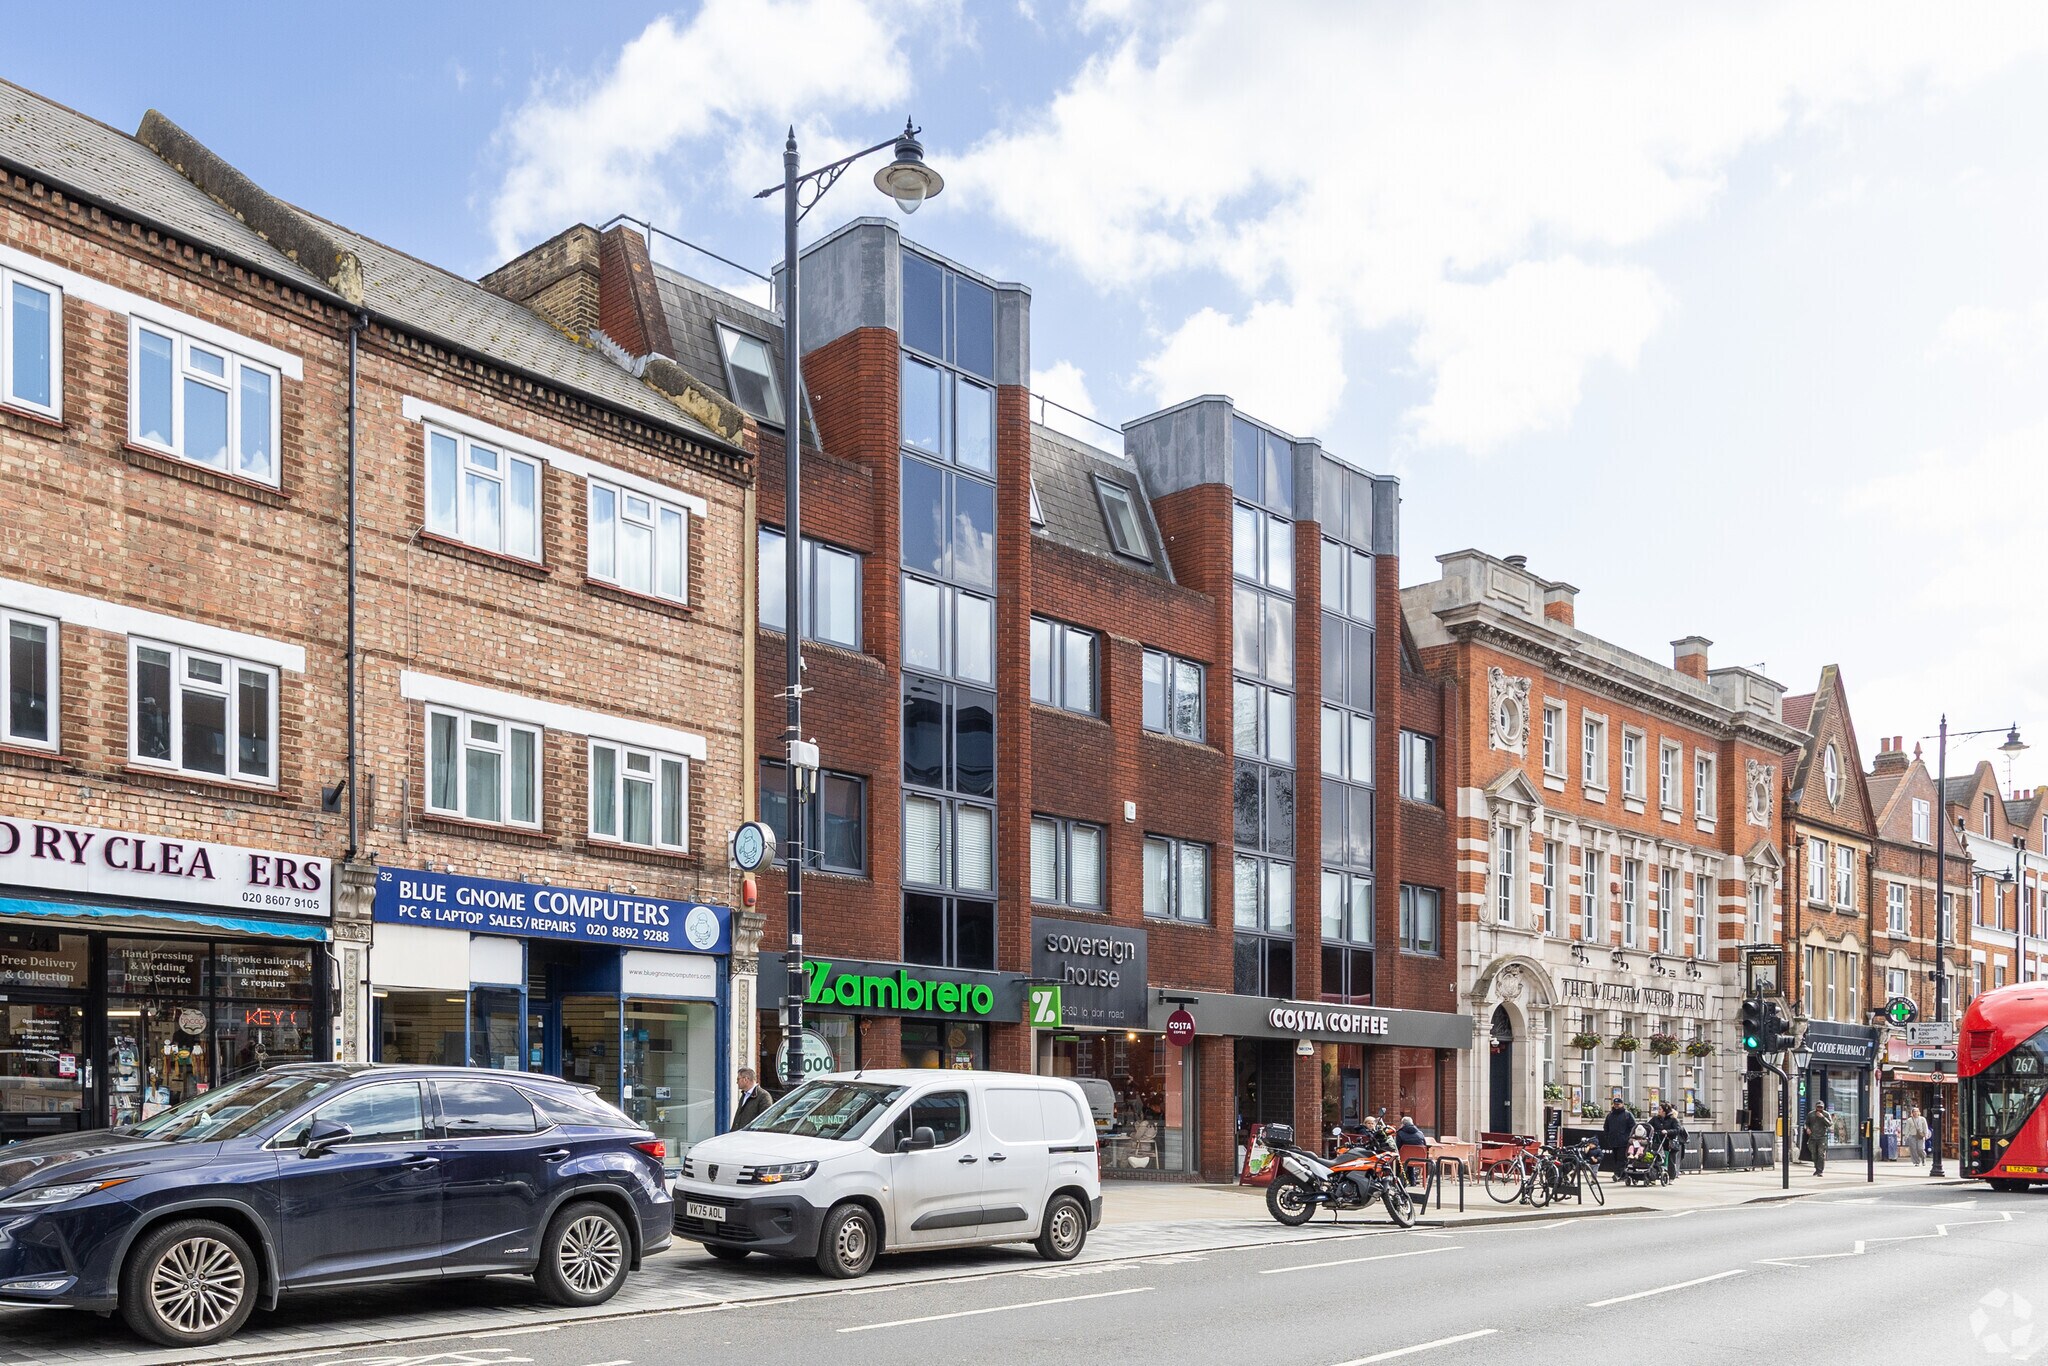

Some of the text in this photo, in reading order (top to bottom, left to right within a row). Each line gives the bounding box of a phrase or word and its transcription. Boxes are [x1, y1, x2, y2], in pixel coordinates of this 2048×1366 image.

[380, 872, 392, 882] 32
[242, 891, 320, 910] 020 8607 9105
[399, 881, 670, 926] BLUE GNOME COMPUTERS
[399, 905, 669, 942] PC & LAPTOP SALES/REPAIRS 020 8892 9288
[122, 949, 194, 962] Hand pressing
[1047, 933, 1135, 965] sovereign
[1, 955, 77, 970] Free Delivery
[221, 954, 262, 965] Bespoke
[130, 962, 186, 973] & Wedding
[236, 967, 289, 977] alterations
[629, 969, 712, 980] www.bluegnomecomputers.com
[1063, 961, 1120, 988] house
[5, 969, 74, 982] & Collection
[124, 973, 191, 983] Dress Service
[250, 979, 286, 988] repairs
[802, 961, 994, 1015] Zambrero
[1562, 980, 1705, 1011] THE WILLIAM WEBB ELLIS
[246, 1009, 284, 1026] KEY
[1108, 1009, 1125, 1019] road
[1269, 1008, 1389, 1035] COSTA COFFEE
[1169, 1022, 1191, 1031] COSTA
[1817, 1042, 1836, 1054] GOODE
[1836, 1043, 1867, 1057] PHARMACY
[2015, 1057, 2035, 1072] 267
[689, 1203, 723, 1219] VK75 AOL
